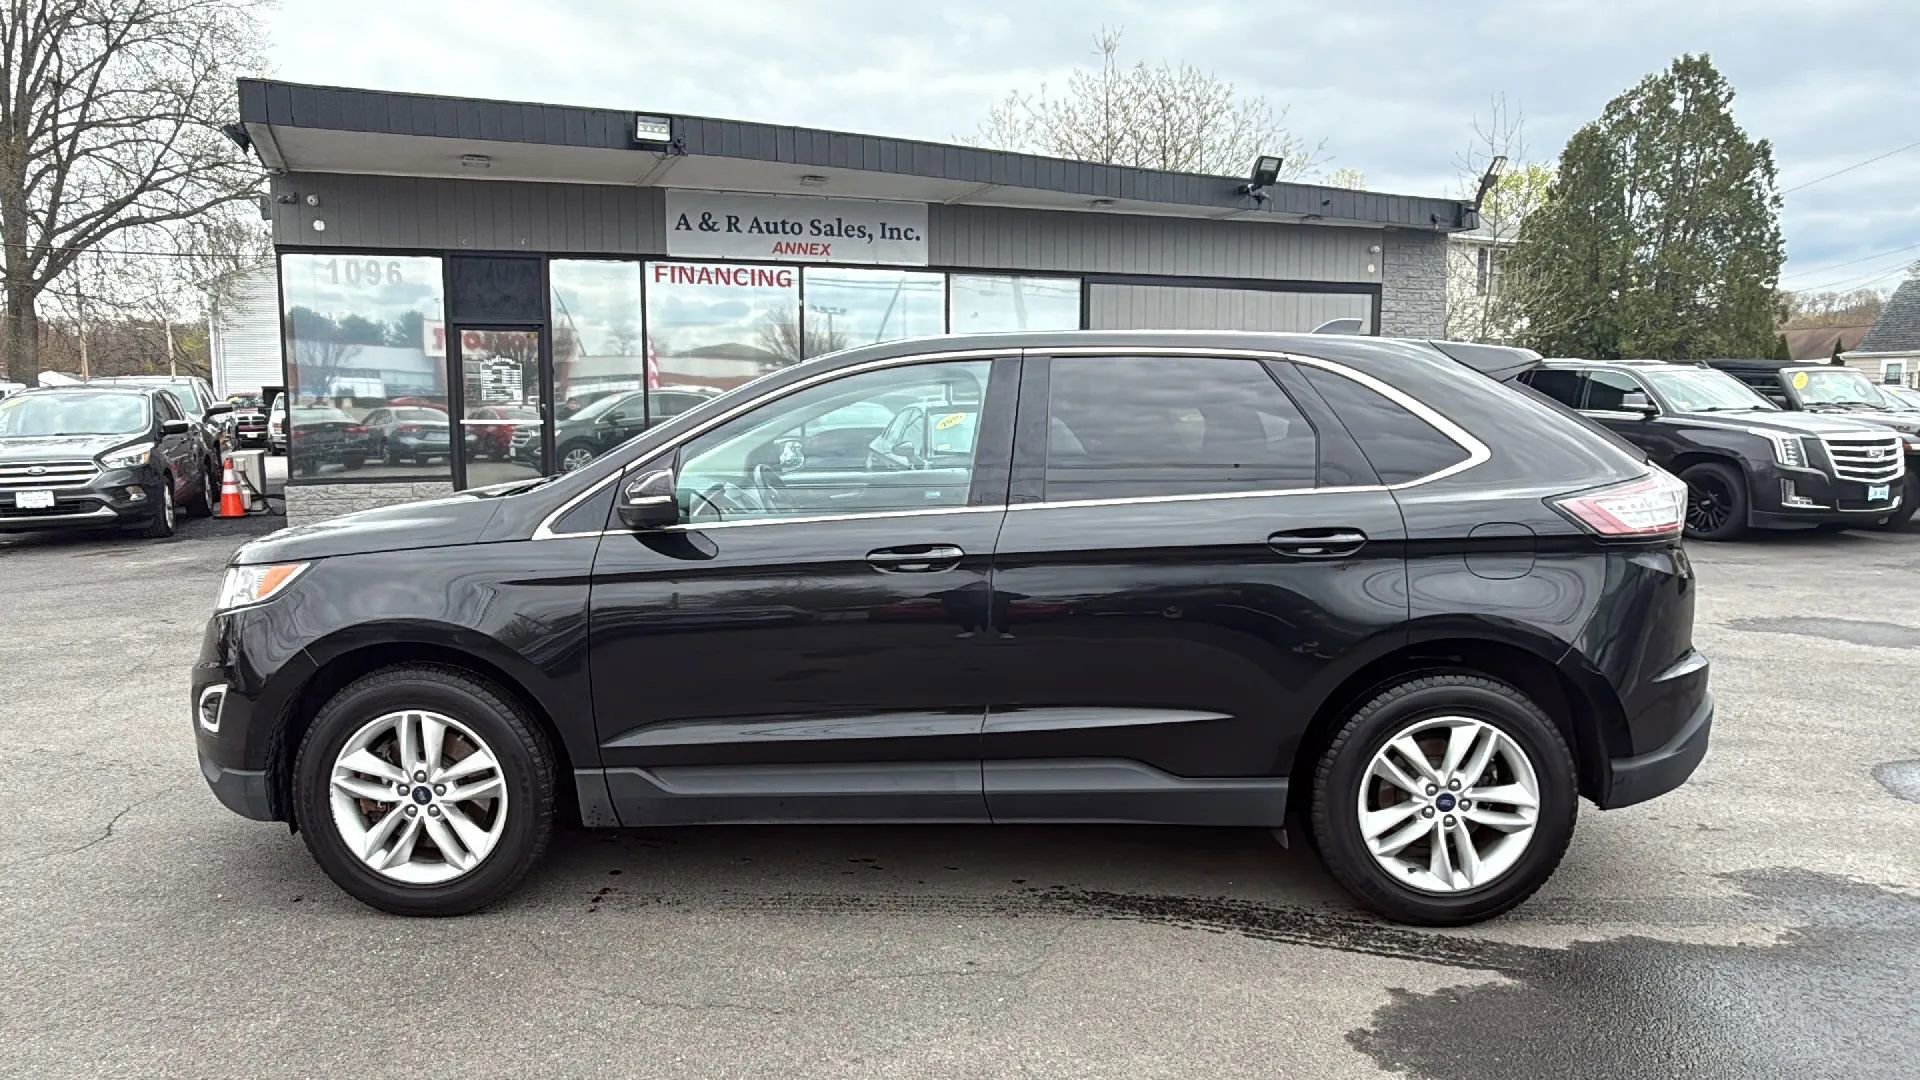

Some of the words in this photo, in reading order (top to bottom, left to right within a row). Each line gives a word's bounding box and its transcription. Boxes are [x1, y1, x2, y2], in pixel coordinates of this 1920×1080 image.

[675, 213, 692, 231] A
[698, 211, 720, 232] &
[726, 215, 743, 233] R
[748, 216, 803, 236] Auto
[809, 217, 873, 243] Sales,
[880, 222, 921, 241] Inc.
[771, 241, 831, 256] ANNEX
[326, 258, 401, 285] 1096
[655, 265, 793, 288] FINANCING
